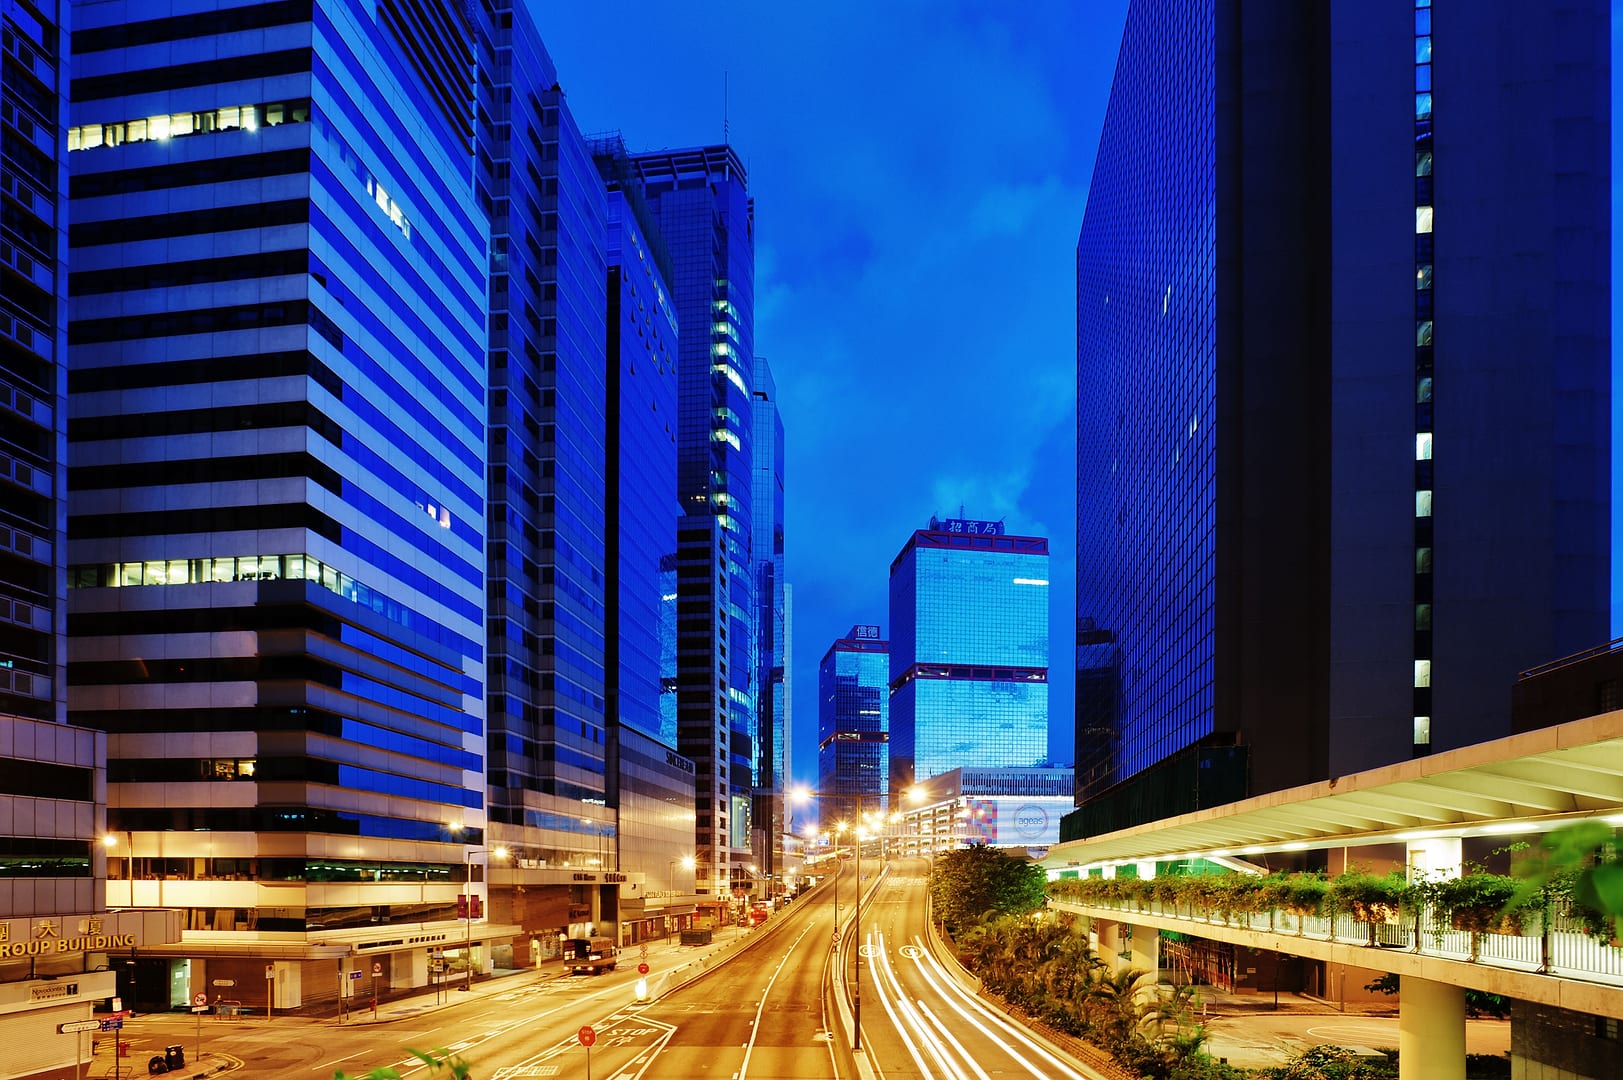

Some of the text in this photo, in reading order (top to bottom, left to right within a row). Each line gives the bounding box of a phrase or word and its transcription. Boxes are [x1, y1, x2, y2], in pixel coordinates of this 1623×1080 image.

[949, 520, 997, 535] 招商局
[1019, 817, 1044, 827] ageas
[0, 933, 135, 957] ROUP BUILDING
[606, 1028, 658, 1036] STOP
